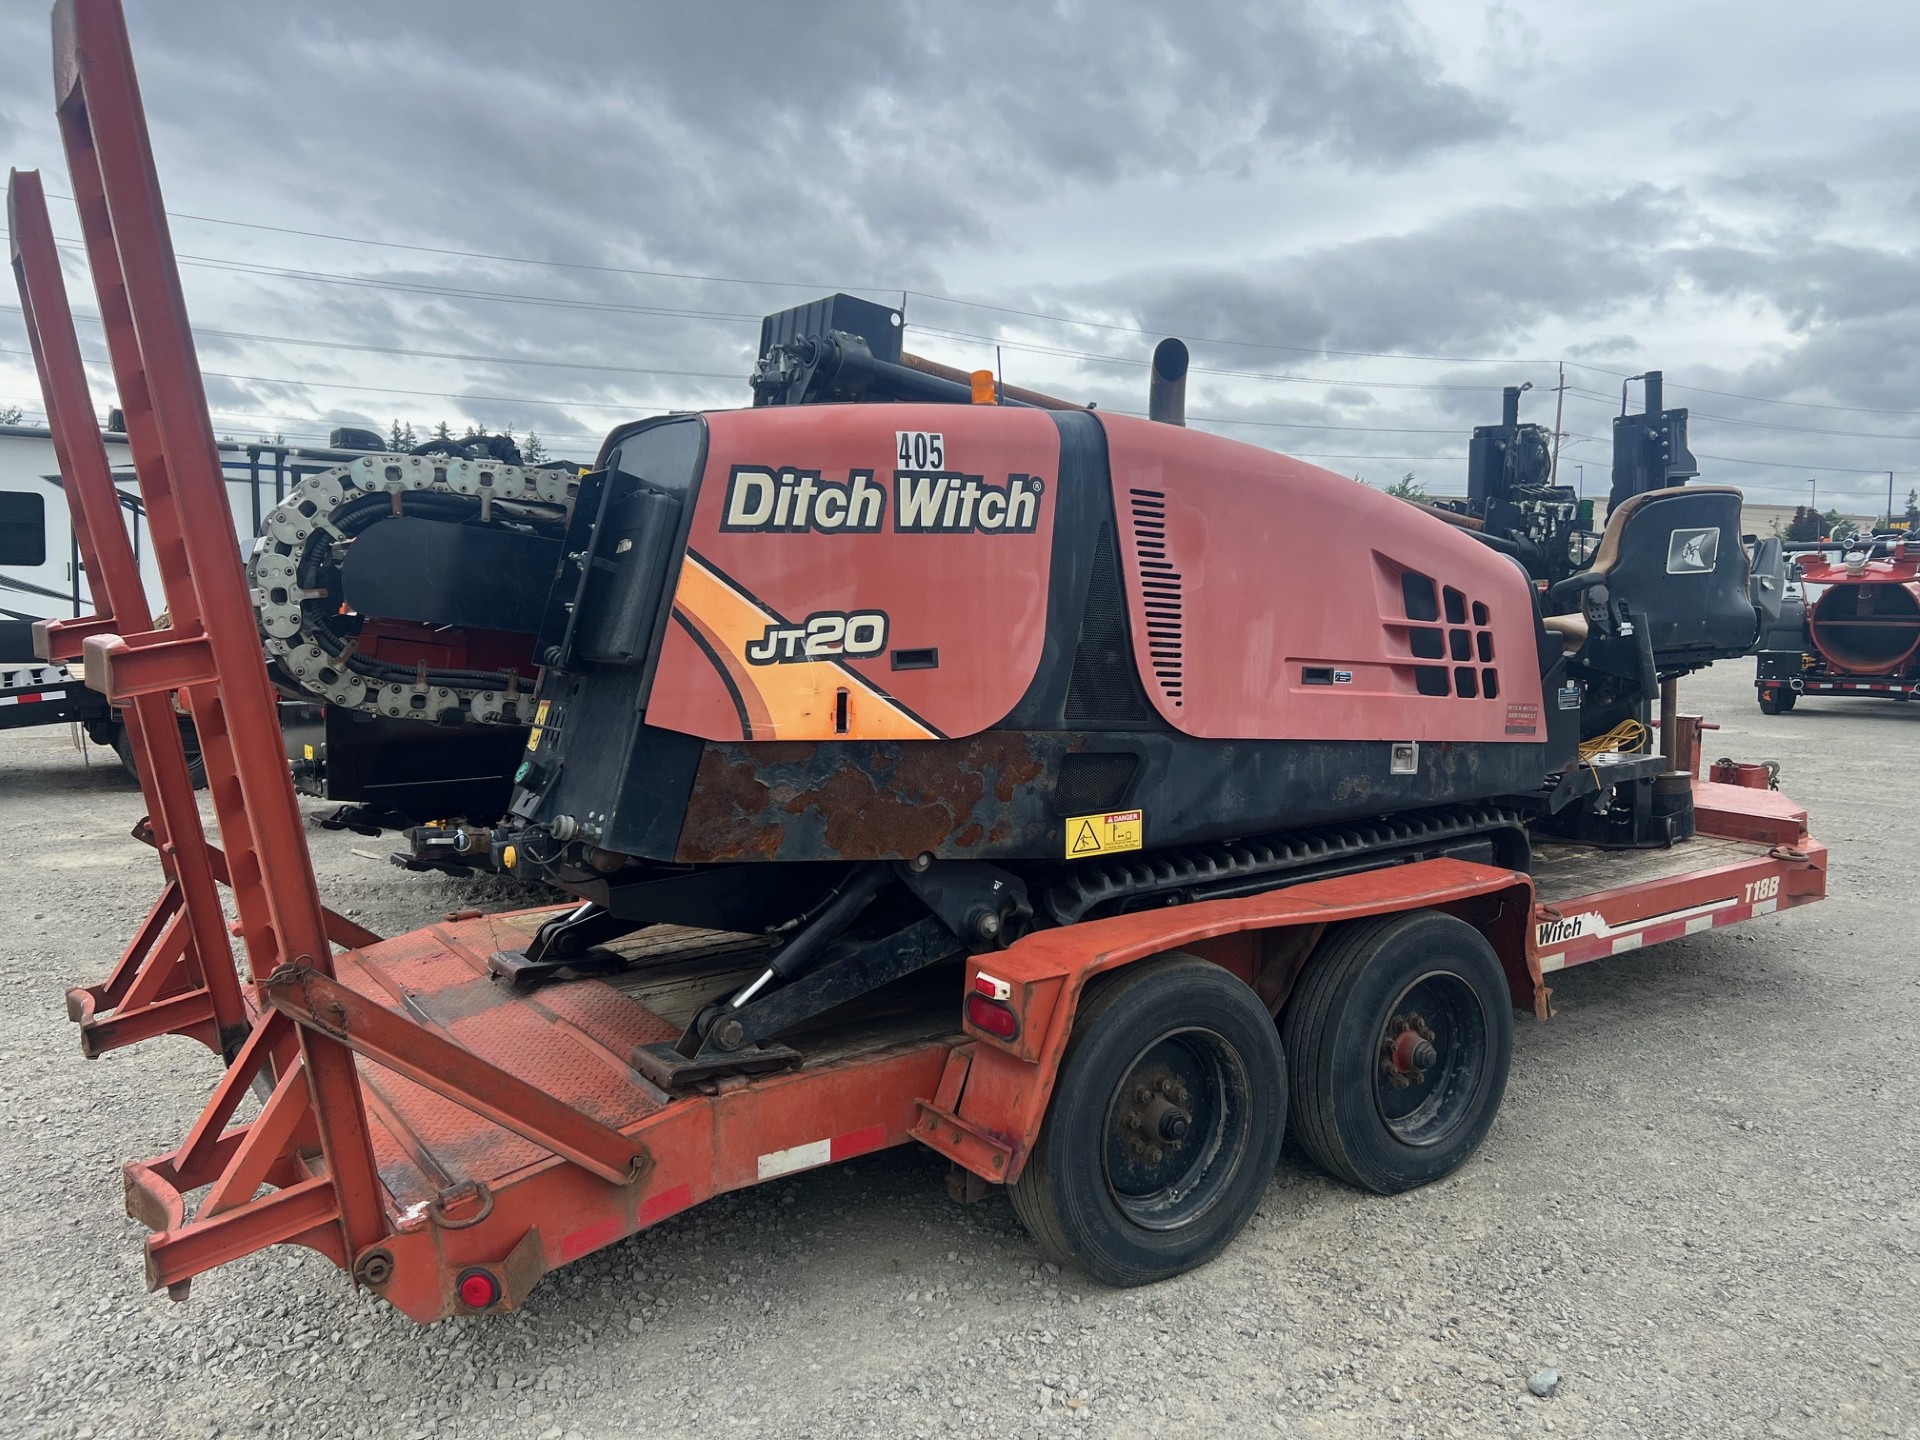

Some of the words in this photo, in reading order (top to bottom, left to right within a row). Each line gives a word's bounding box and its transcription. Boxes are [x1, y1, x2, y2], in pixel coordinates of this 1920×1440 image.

[898, 432, 943, 470] 405
[727, 472, 882, 528] Ditch
[750, 615, 885, 660] JT20
[1113, 813, 1138, 822] DANGER
[1745, 875, 1781, 903] T18B
[1539, 916, 1582, 945] Witch
